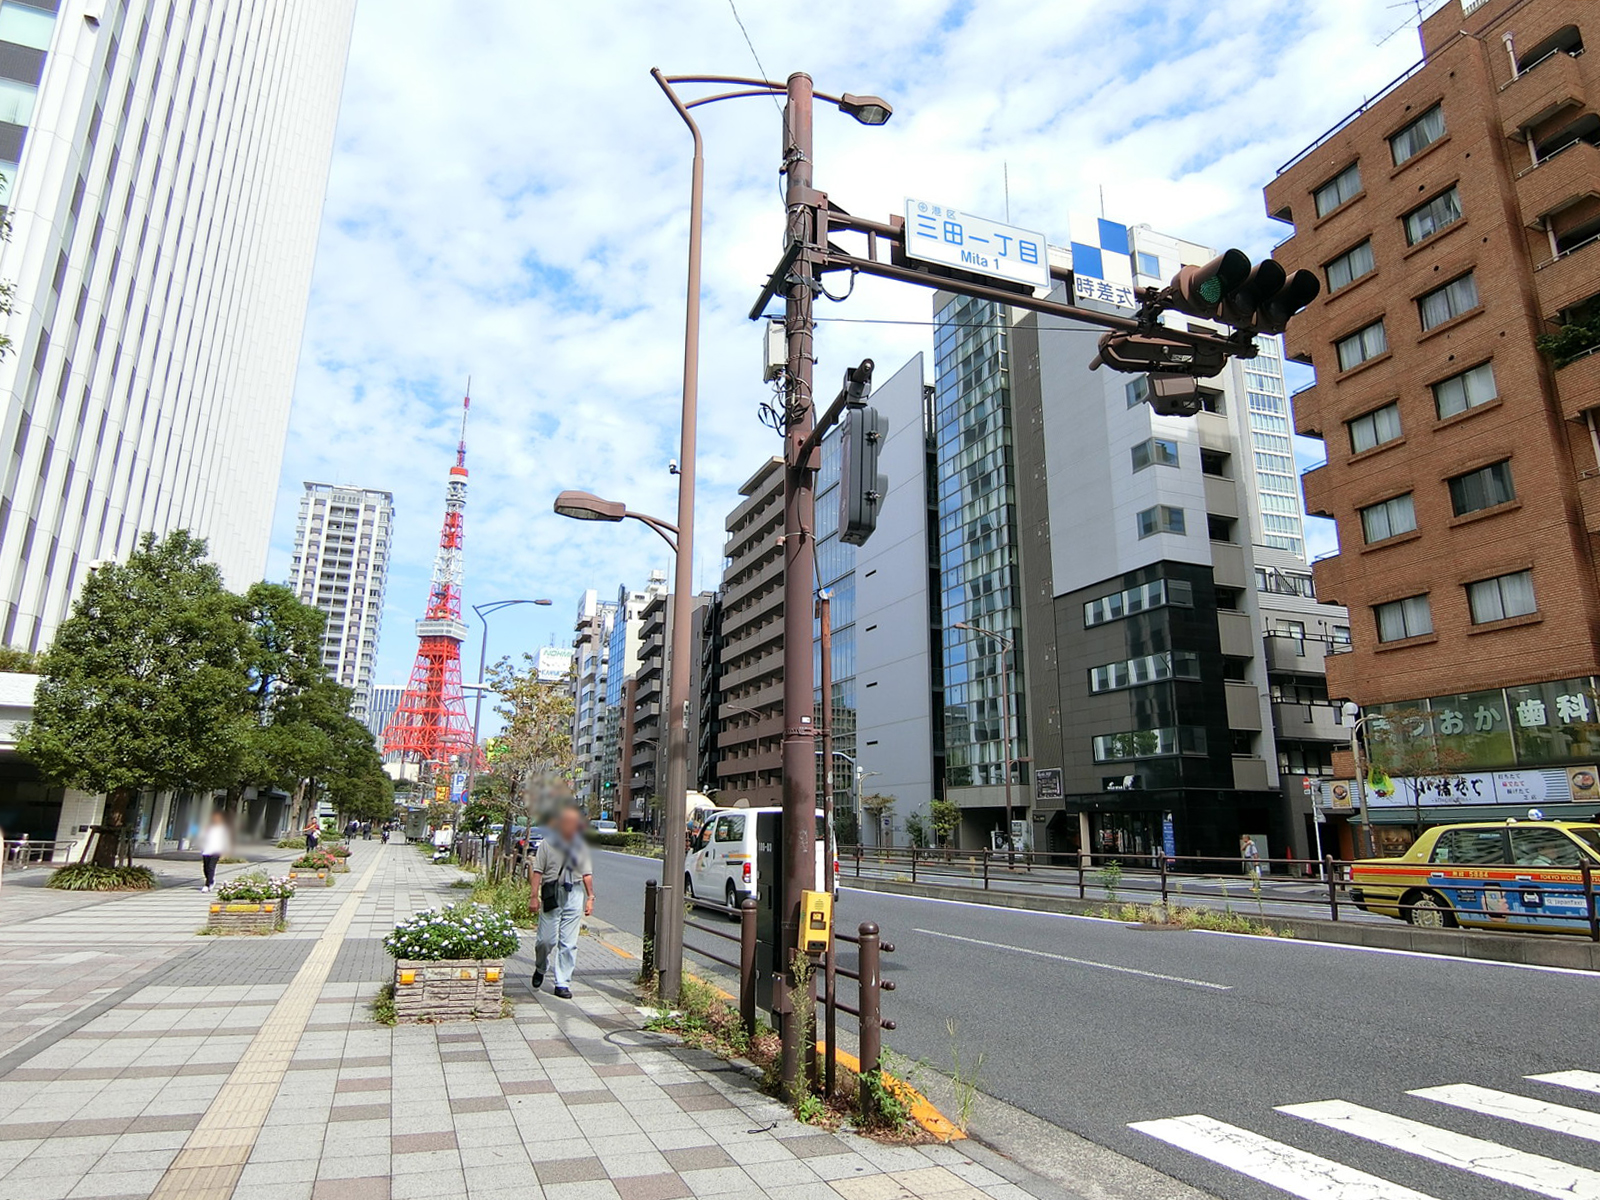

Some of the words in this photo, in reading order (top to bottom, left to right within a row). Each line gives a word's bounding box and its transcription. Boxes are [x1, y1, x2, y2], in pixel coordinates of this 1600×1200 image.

[931, 205, 957, 220] 港区
[917, 214, 1038, 265] 三田一丁目
[961, 250, 988, 267] Mita
[993, 258, 1000, 270] 1
[1076, 277, 1135, 307] 時差式
